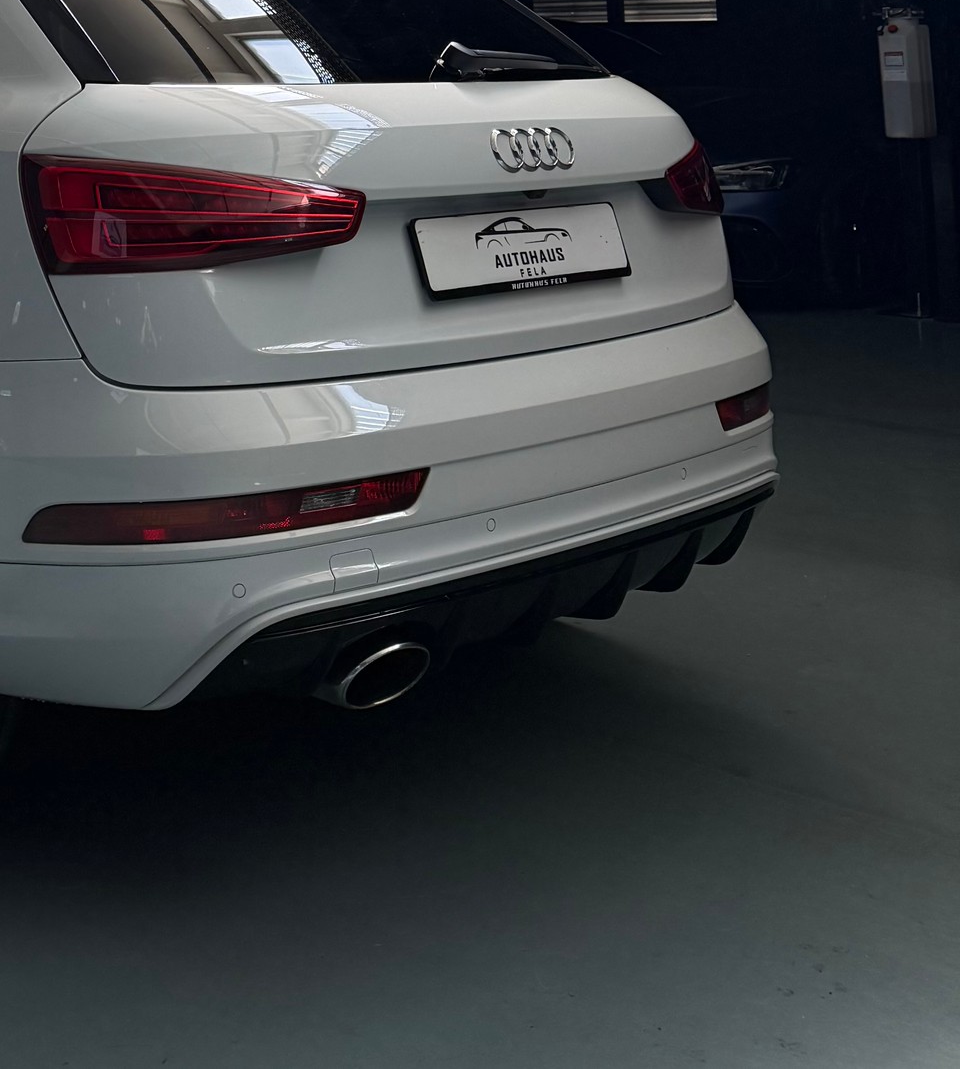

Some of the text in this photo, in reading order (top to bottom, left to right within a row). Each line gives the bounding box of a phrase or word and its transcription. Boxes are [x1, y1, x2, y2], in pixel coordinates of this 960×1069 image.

[495, 247, 565, 269] AUTOHAUS
[520, 267, 547, 278] FELA
[511, 277, 568, 290] AUTOHAUS FELA
